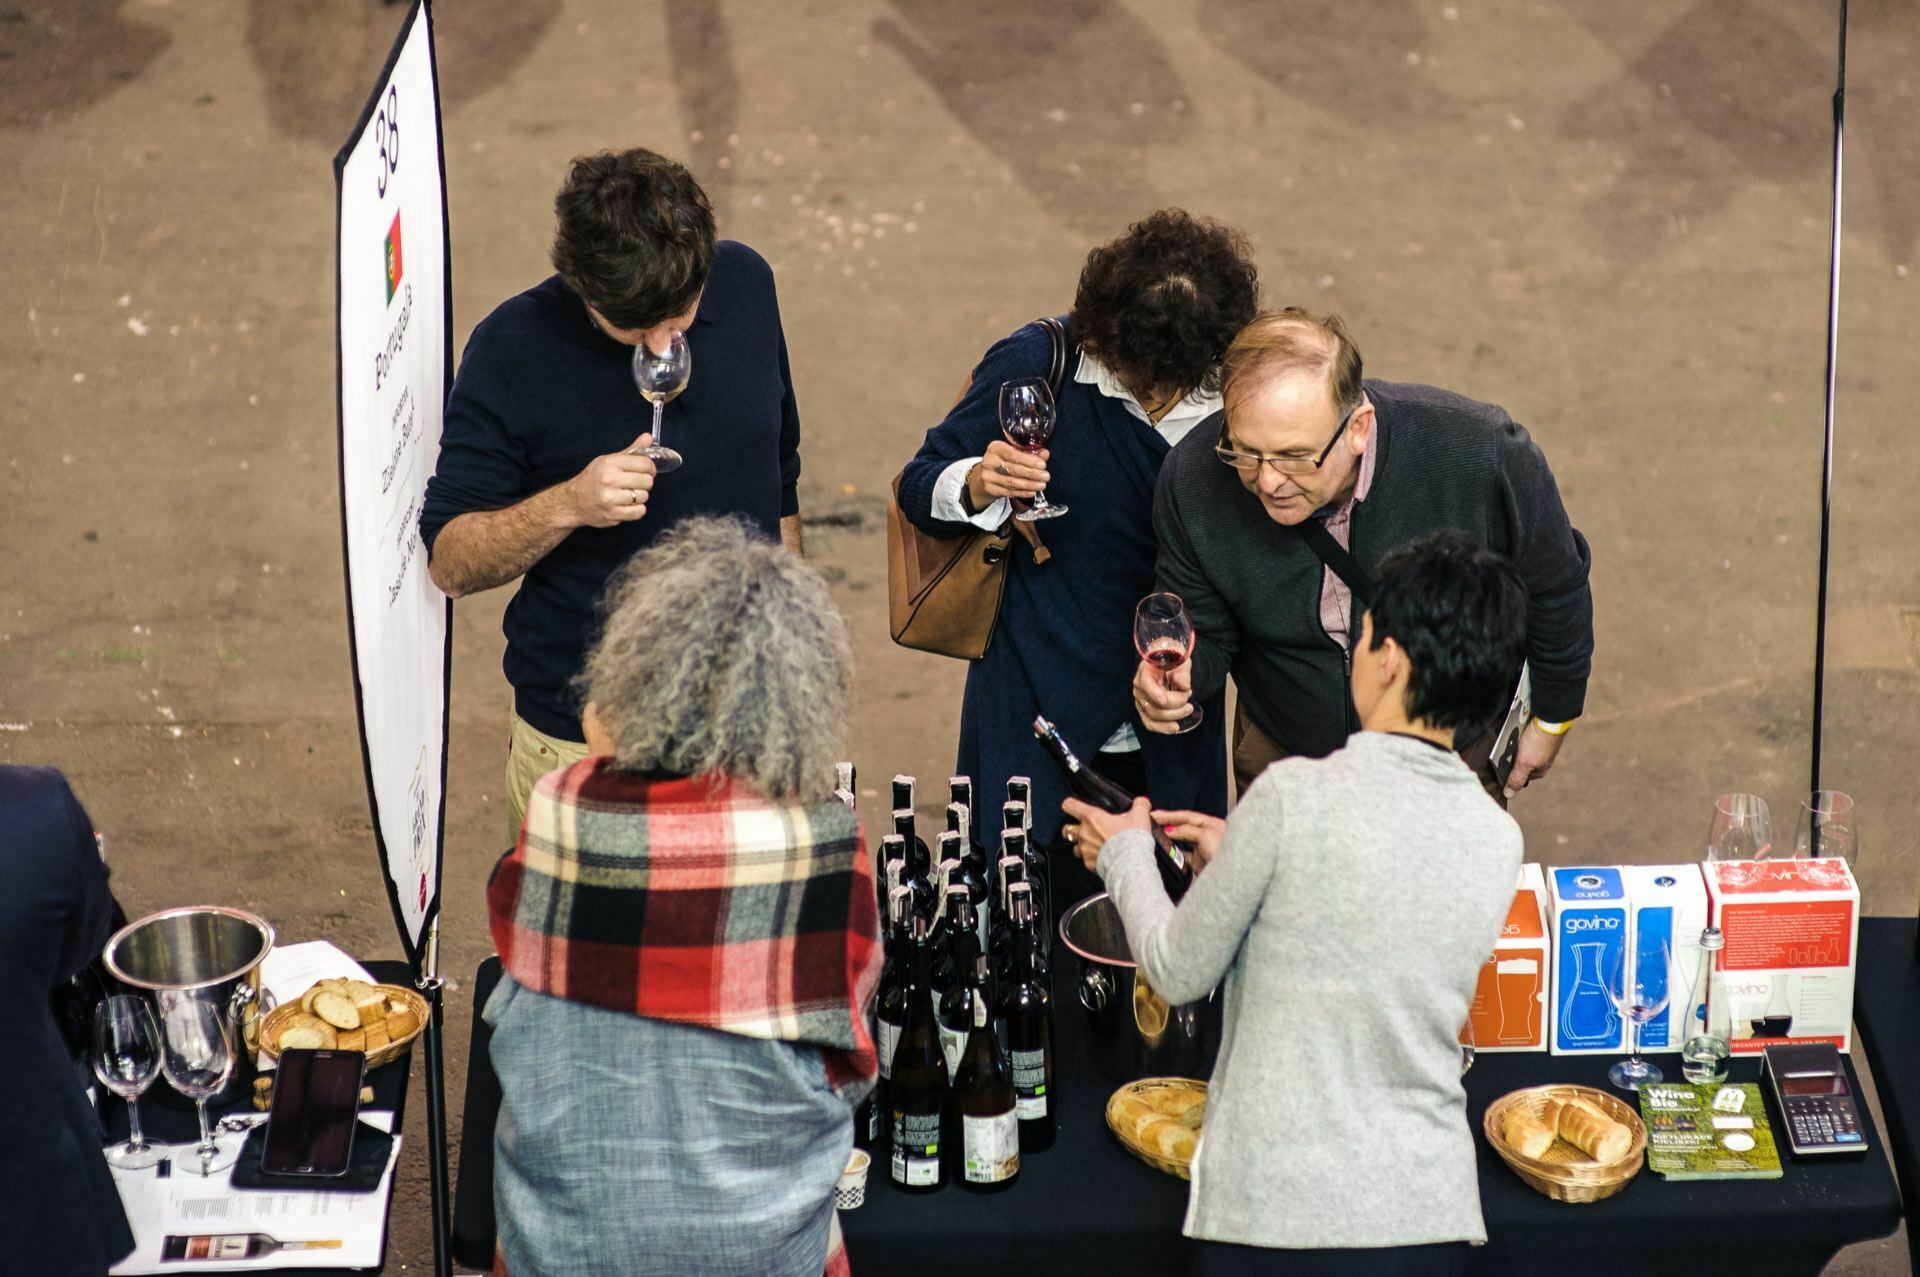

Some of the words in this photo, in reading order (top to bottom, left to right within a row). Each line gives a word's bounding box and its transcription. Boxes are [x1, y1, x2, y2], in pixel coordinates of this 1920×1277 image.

[376, 84, 399, 199] 38
[1565, 914, 1620, 934] govino
[1647, 1088, 1695, 1099] Wina
[1650, 1098, 1678, 1107] Bio
